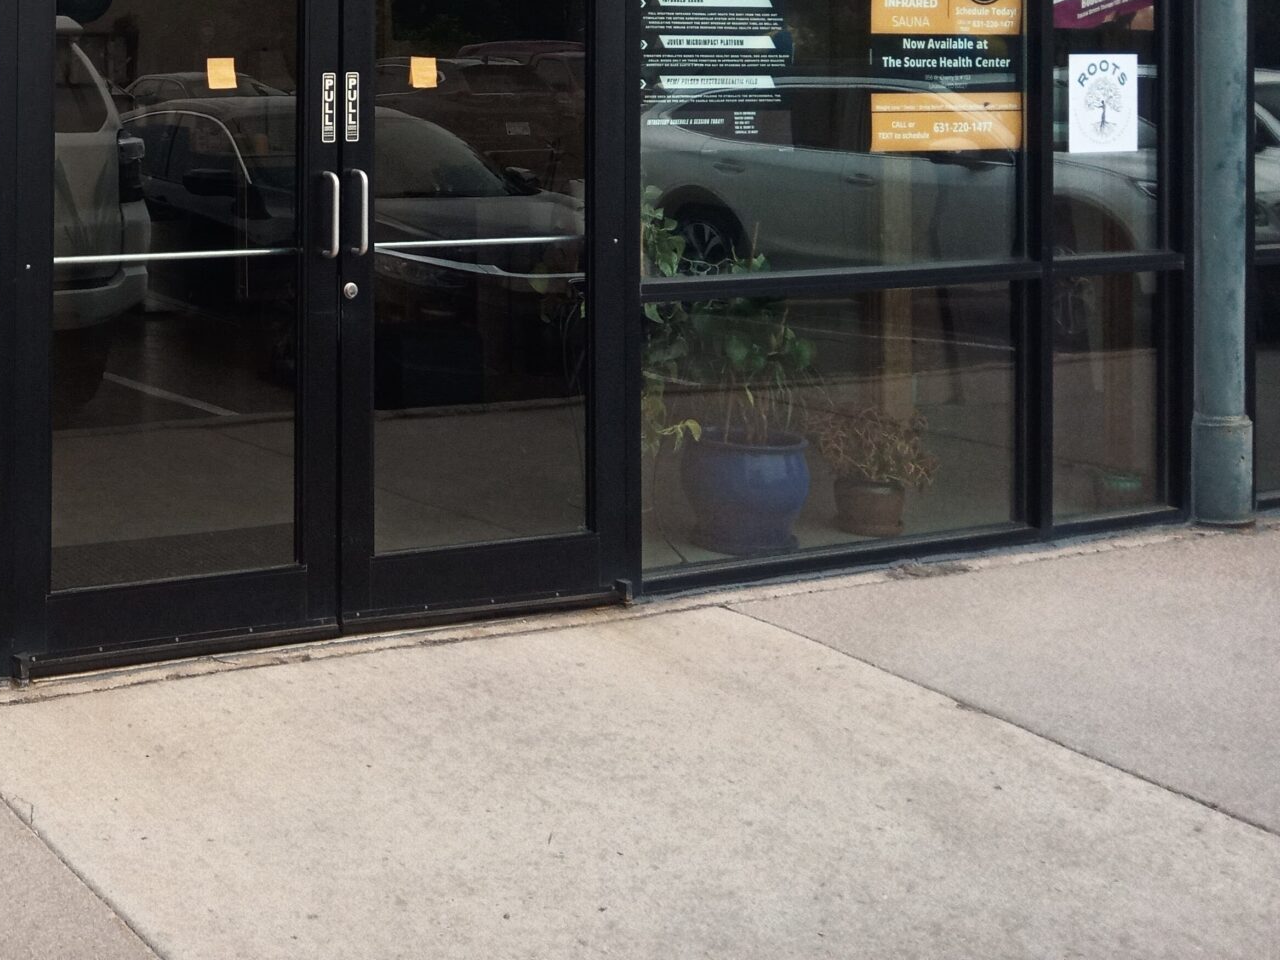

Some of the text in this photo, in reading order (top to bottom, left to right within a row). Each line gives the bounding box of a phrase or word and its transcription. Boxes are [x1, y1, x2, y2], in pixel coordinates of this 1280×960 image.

[955, 7, 1016, 18] Schedule Today!
[892, 16, 930, 27] SAUNA
[903, 38, 988, 50] Now Available at
[882, 57, 1011, 68] The Source Health Center
[1078, 60, 1128, 88] ROOTS
[325, 79, 334, 126] PULL
[348, 78, 357, 125] PULL
[933, 122, 993, 133] 631-220-1477
